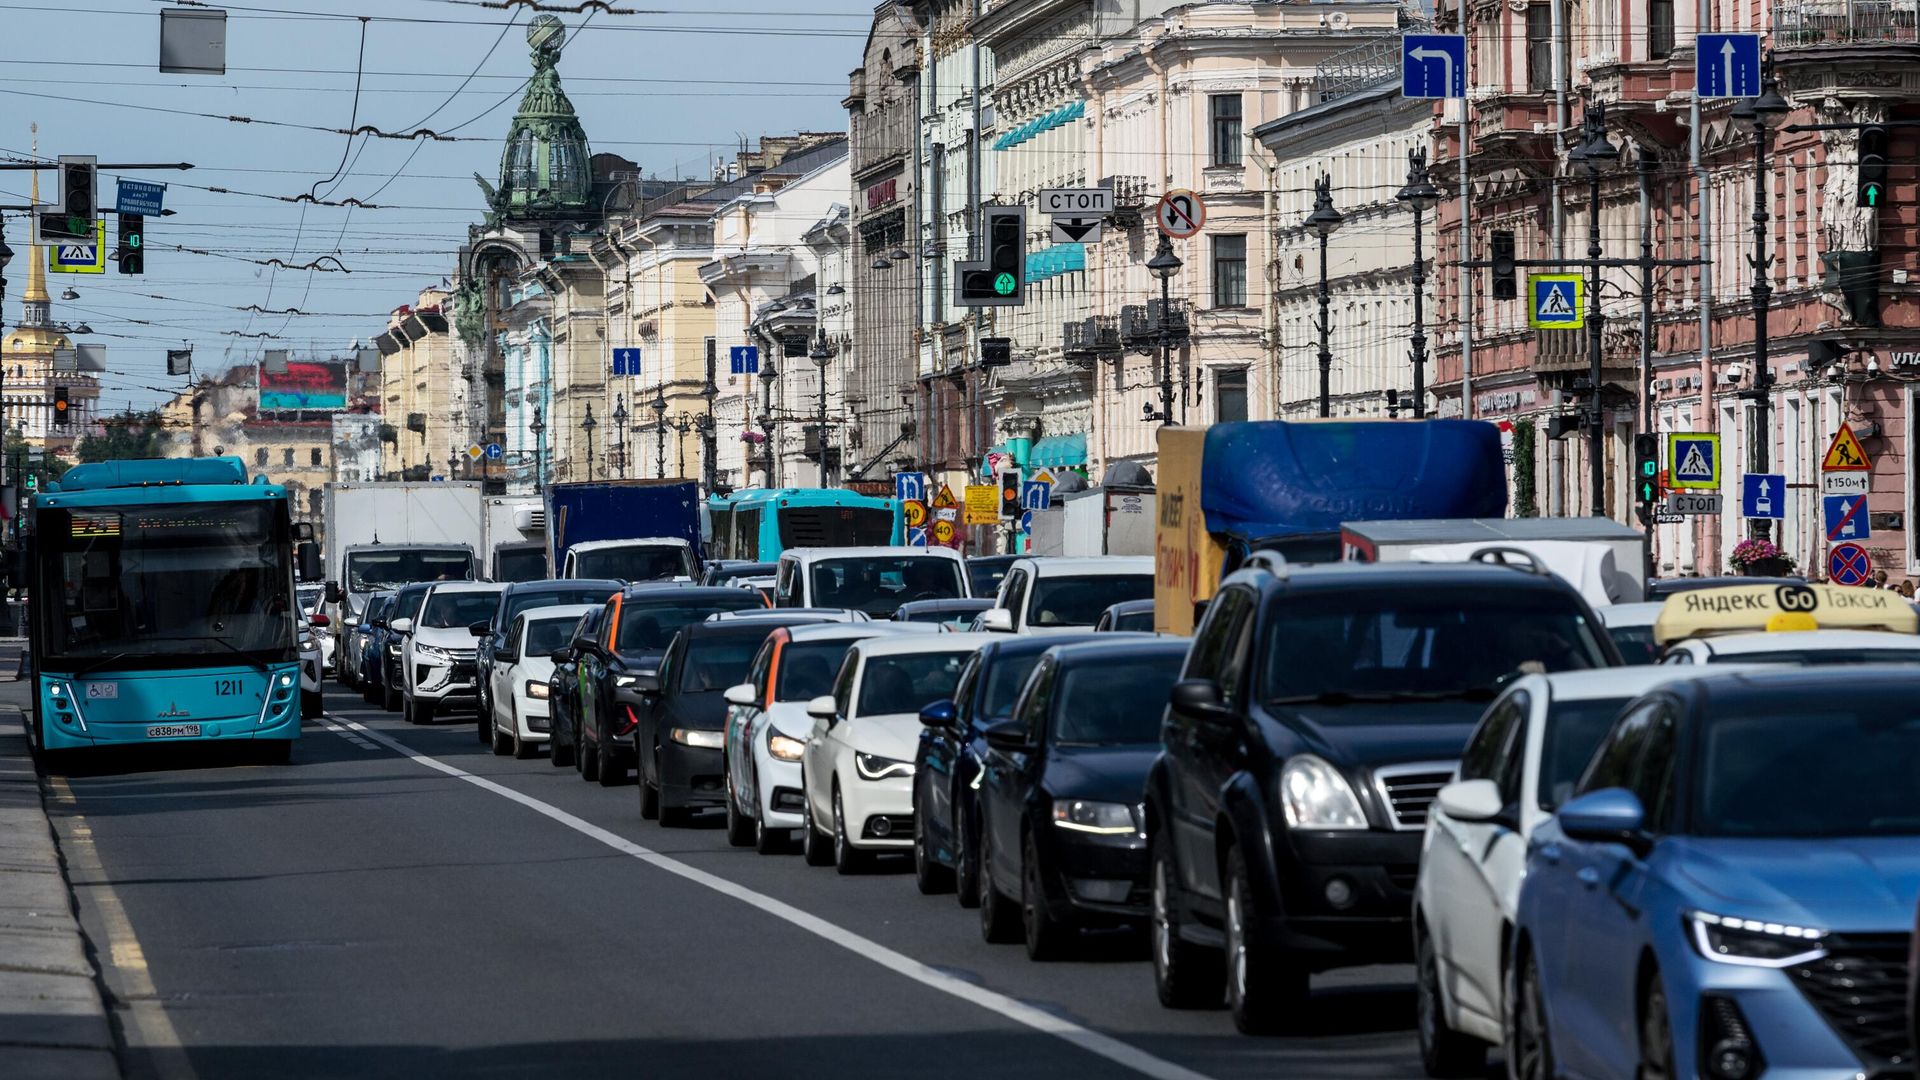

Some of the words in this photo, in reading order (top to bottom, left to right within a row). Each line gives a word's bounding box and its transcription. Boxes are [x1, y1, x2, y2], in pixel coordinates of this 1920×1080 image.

[1050, 194, 1104, 208] СТОП
[130, 234, 140, 247] 10
[1644, 461, 1656, 476] 10
[1834, 478, 1860, 488] 150м
[1676, 497, 1716, 511] СТОП
[936, 526, 950, 535] 40
[1685, 592, 1770, 613] Яндекс
[1779, 585, 1814, 610] Go
[1822, 588, 1888, 609] Такси
[215, 680, 242, 696] 1211
